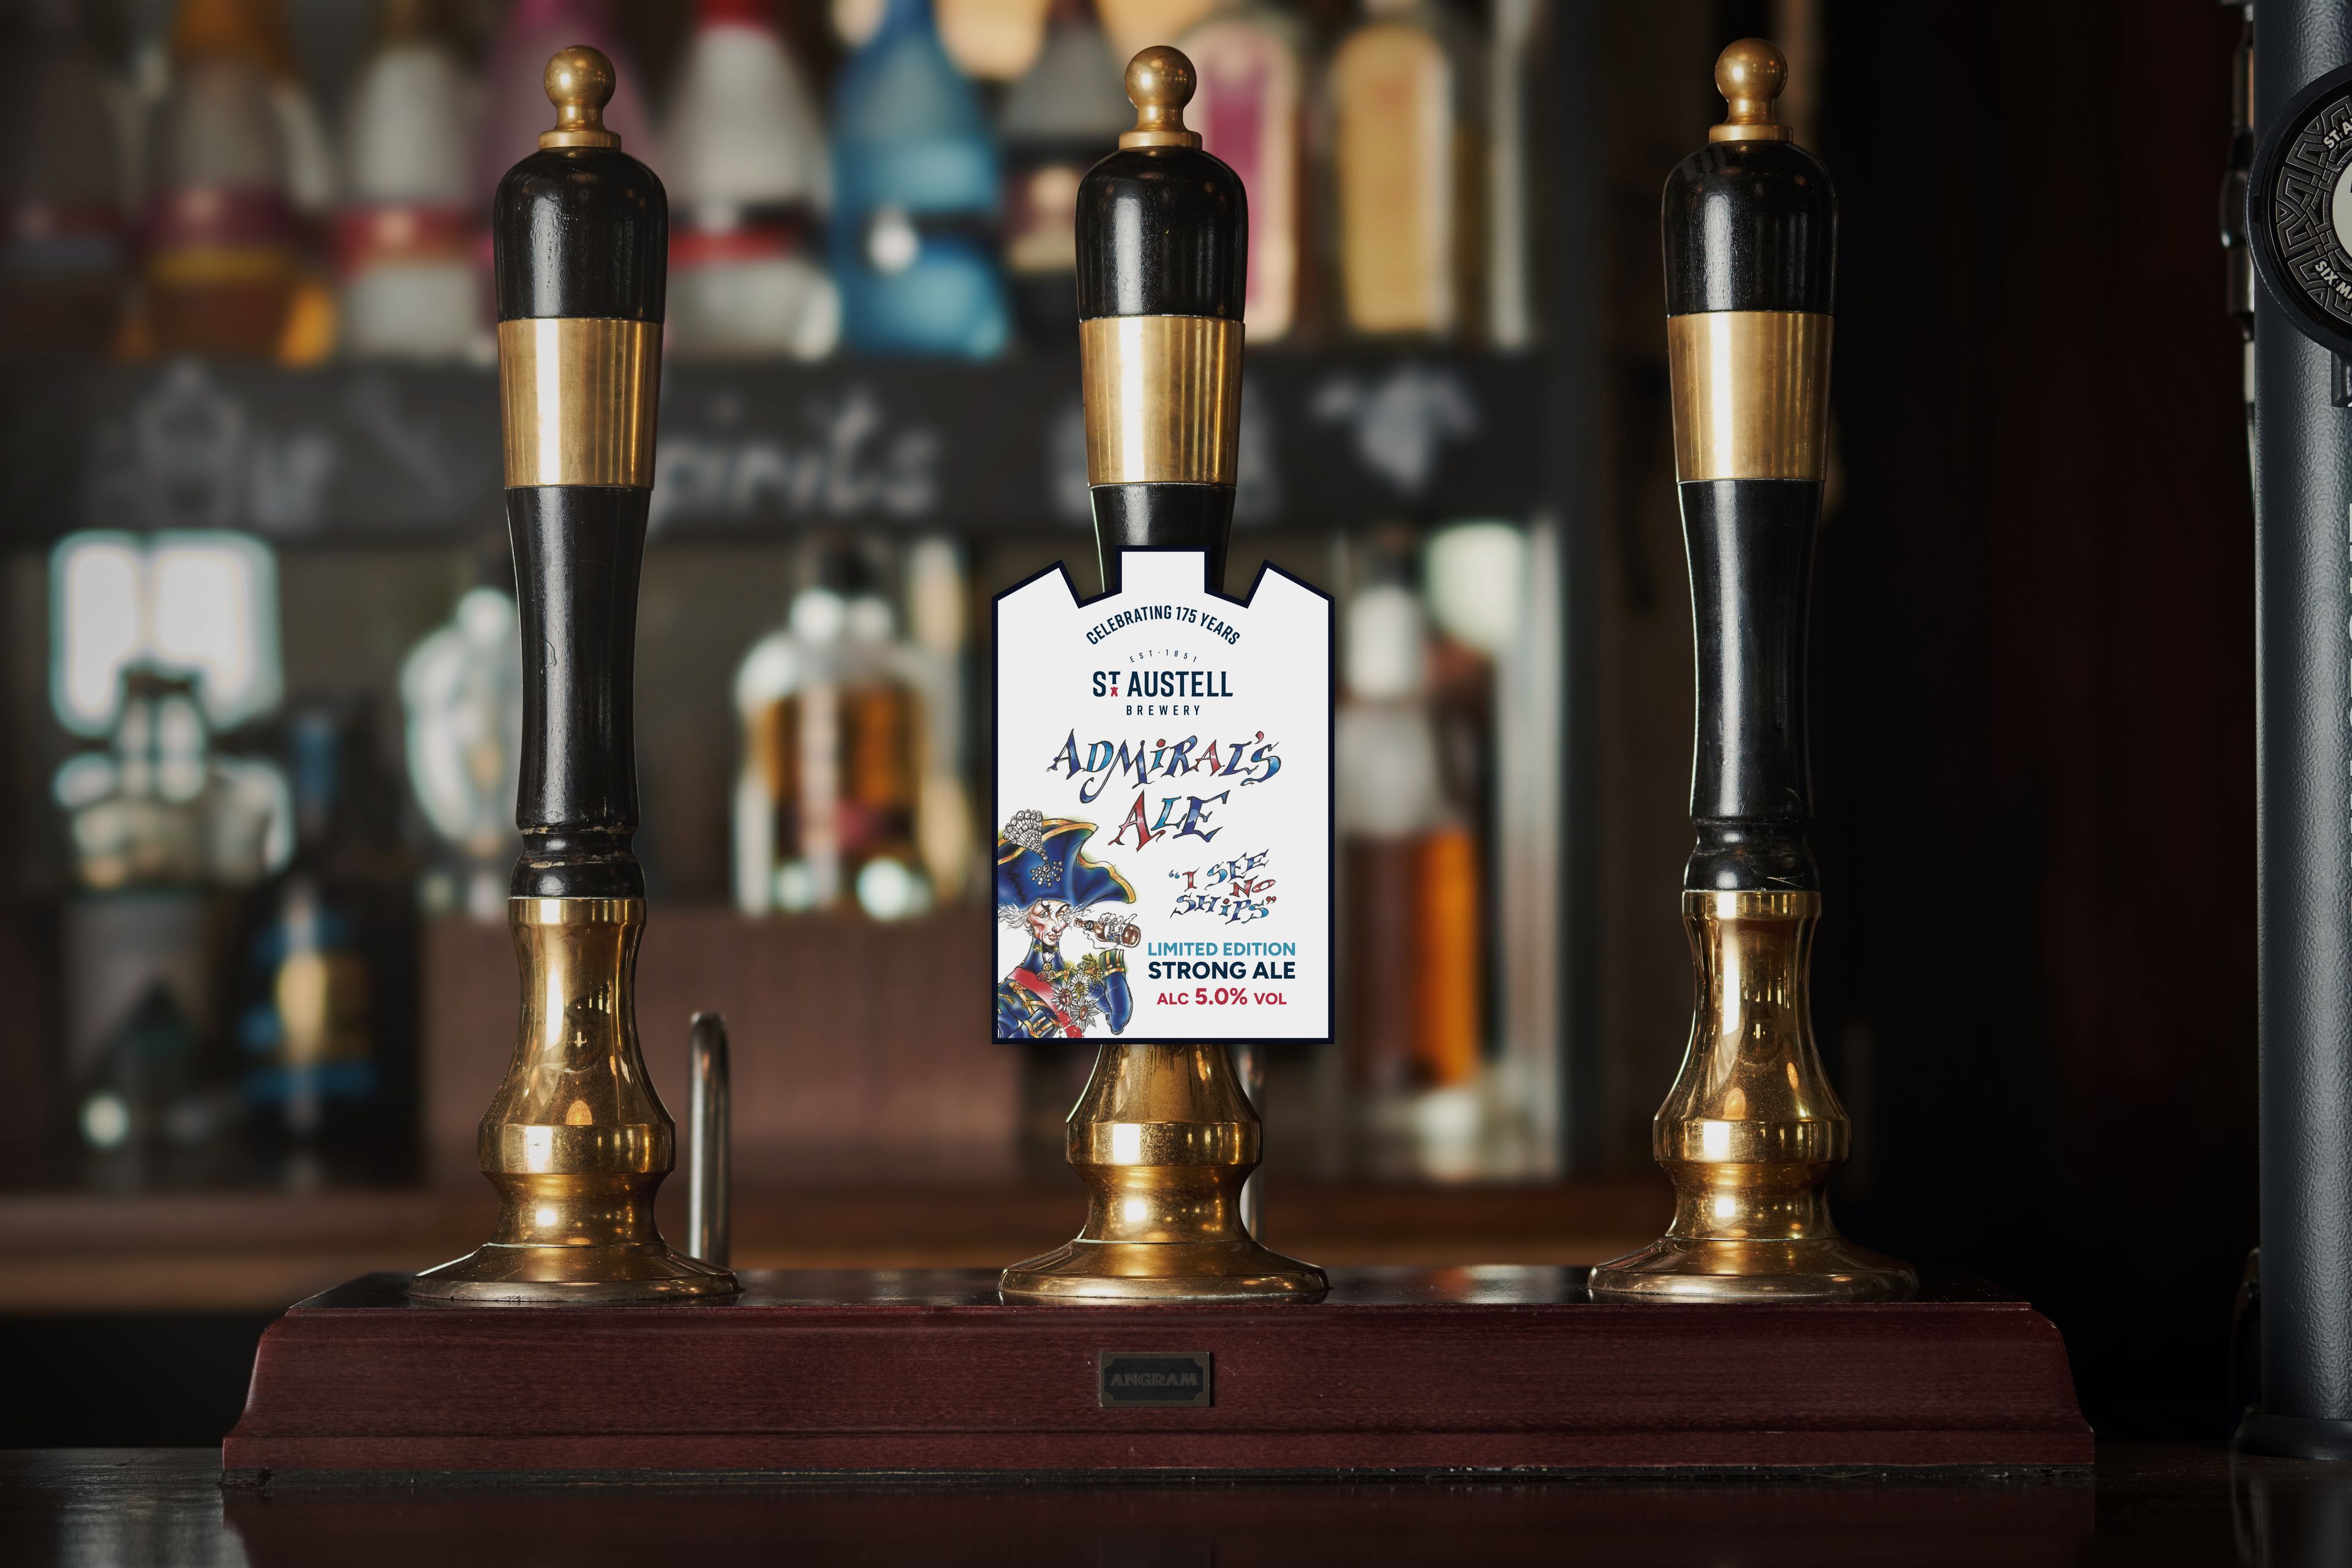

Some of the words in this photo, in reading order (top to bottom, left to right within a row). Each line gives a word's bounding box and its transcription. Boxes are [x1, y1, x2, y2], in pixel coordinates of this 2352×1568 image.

[2315, 260, 2339, 286] SIX
[1086, 605, 1172, 645] CELEBRATING
[1175, 606, 1197, 624] 175
[1200, 612, 1241, 645] YEARS
[1093, 671, 1121, 698] ST
[1126, 671, 1234, 698] AUSTELL
[1126, 705, 1200, 716] BREWERY
[1107, 789, 1231, 853] ALE
[1204, 848, 1270, 891] SEE
[1229, 875, 1276, 899] NO
[1148, 942, 1218, 956] LIMITED
[1223, 941, 1295, 957] EDITION
[1148, 961, 1247, 979] STRONG
[1251, 961, 1296, 979] ALE
[1156, 992, 1189, 1005] ALC
[1195, 987, 1248, 1006] 5.0%
[1253, 992, 1287, 1005] VOL
[1109, 1373, 1198, 1387] ANGRAM
